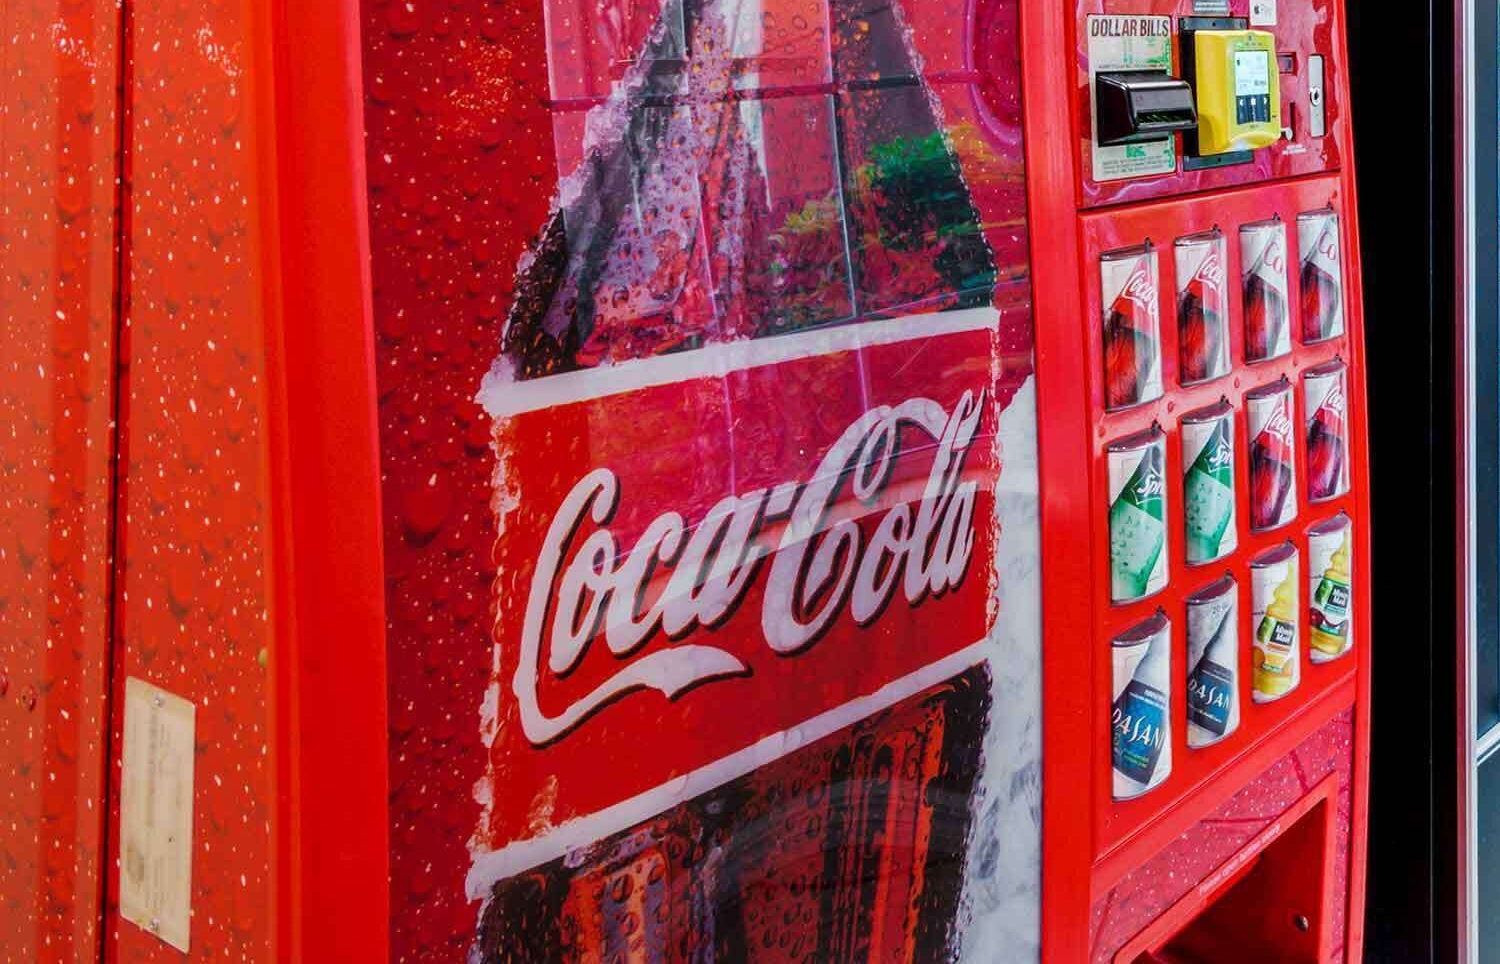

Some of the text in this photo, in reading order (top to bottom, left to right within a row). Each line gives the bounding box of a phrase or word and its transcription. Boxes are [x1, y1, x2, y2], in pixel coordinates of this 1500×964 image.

[1091, 19, 1169, 37] DOLLAR BILLS
[512, 386, 988, 750] Coca-Cola
